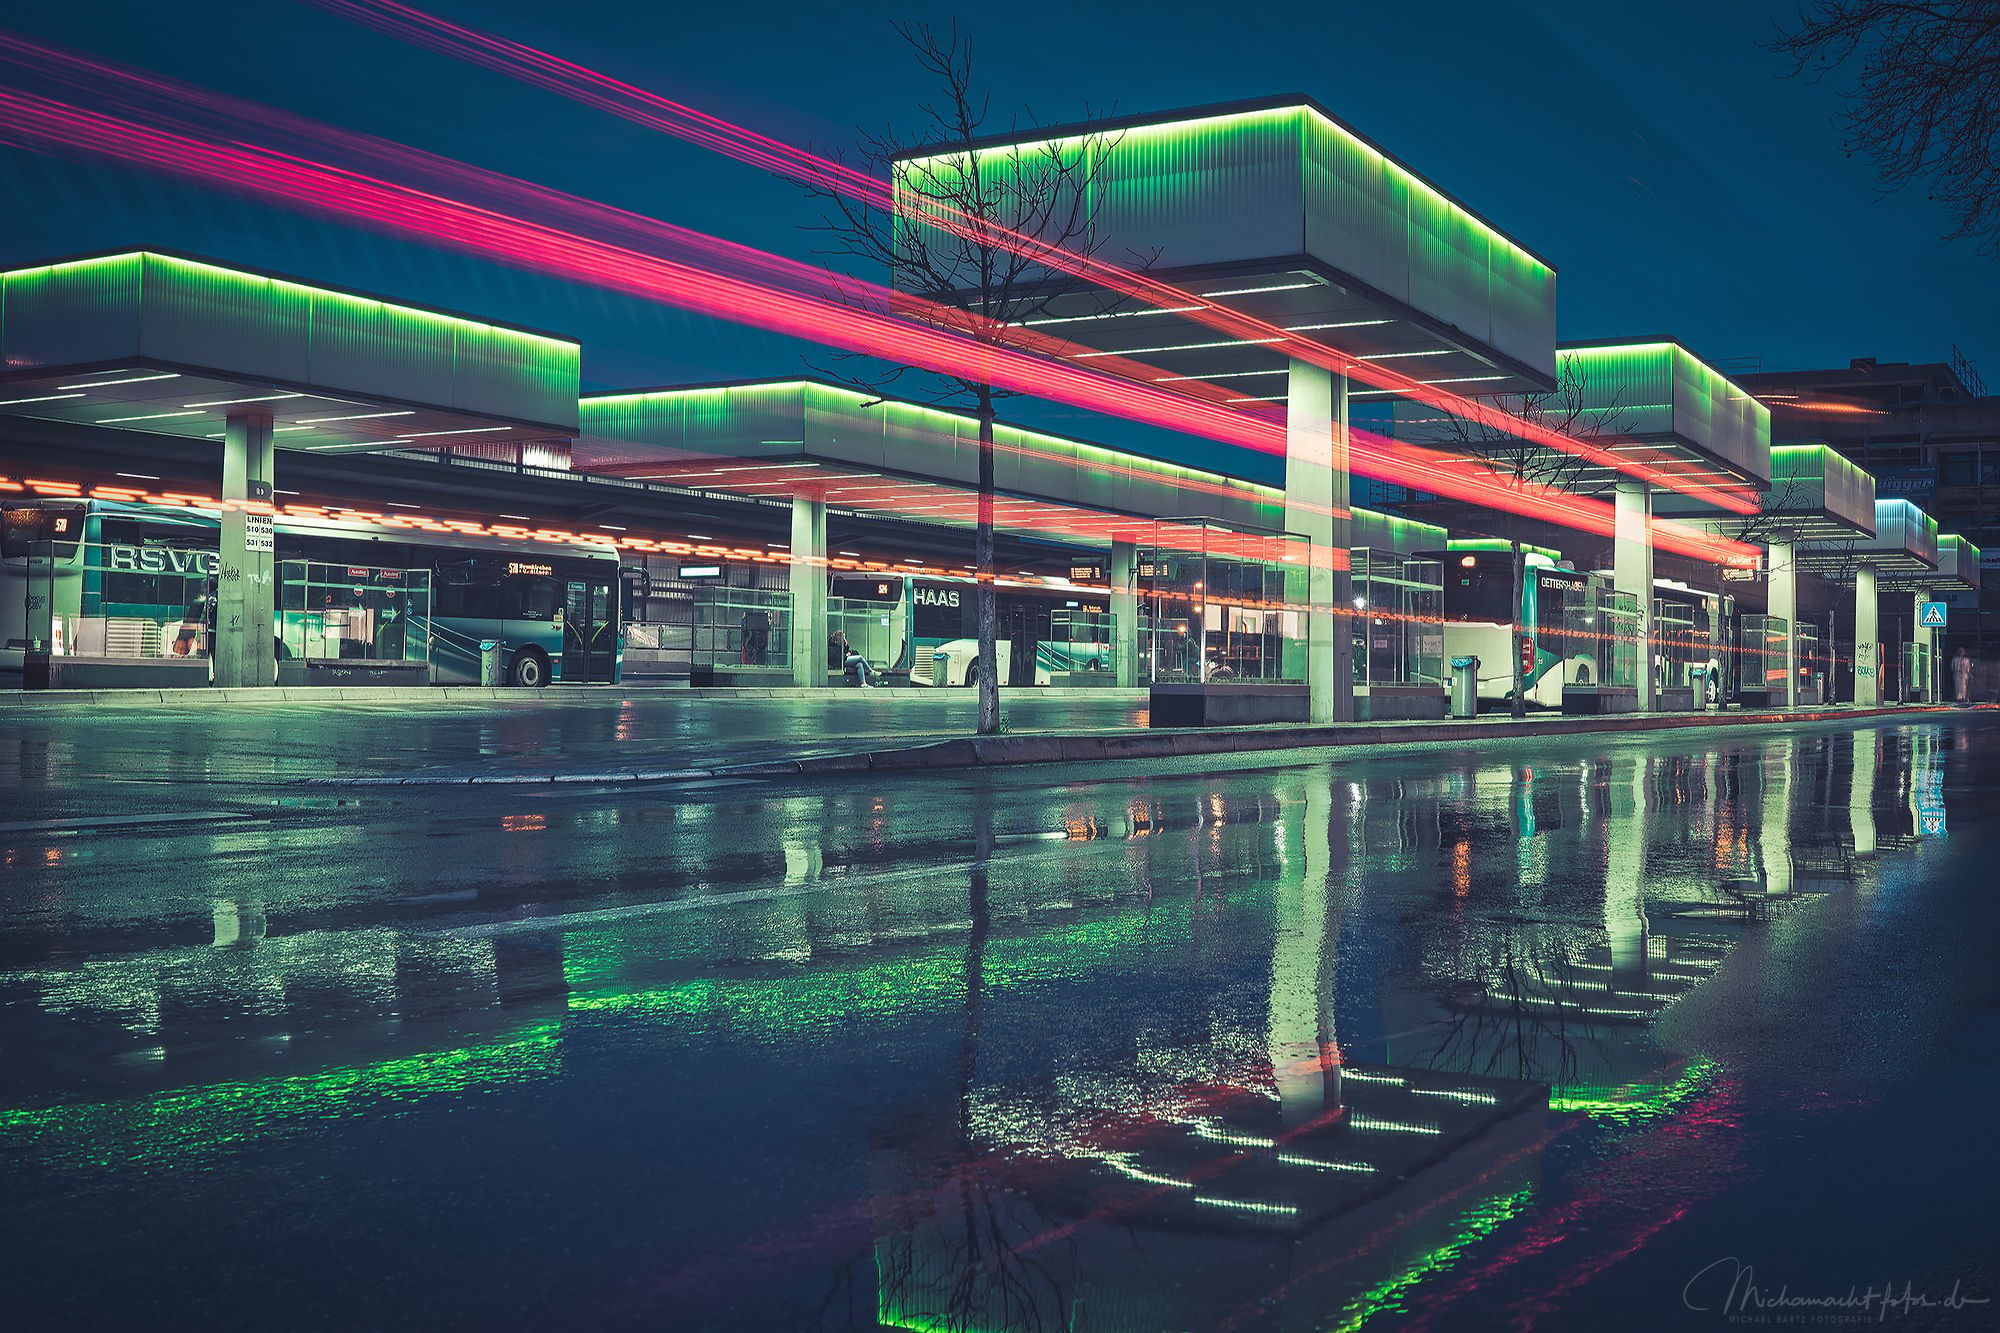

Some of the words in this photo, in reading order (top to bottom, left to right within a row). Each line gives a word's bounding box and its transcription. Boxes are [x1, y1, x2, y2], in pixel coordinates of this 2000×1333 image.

[247, 516, 272, 525] LINIEN
[260, 527, 273, 535] 530
[246, 539, 258, 547] 531
[260, 540, 273, 548] 532
[111, 544, 220, 575] RSVG
[913, 587, 960, 607] HAAS
